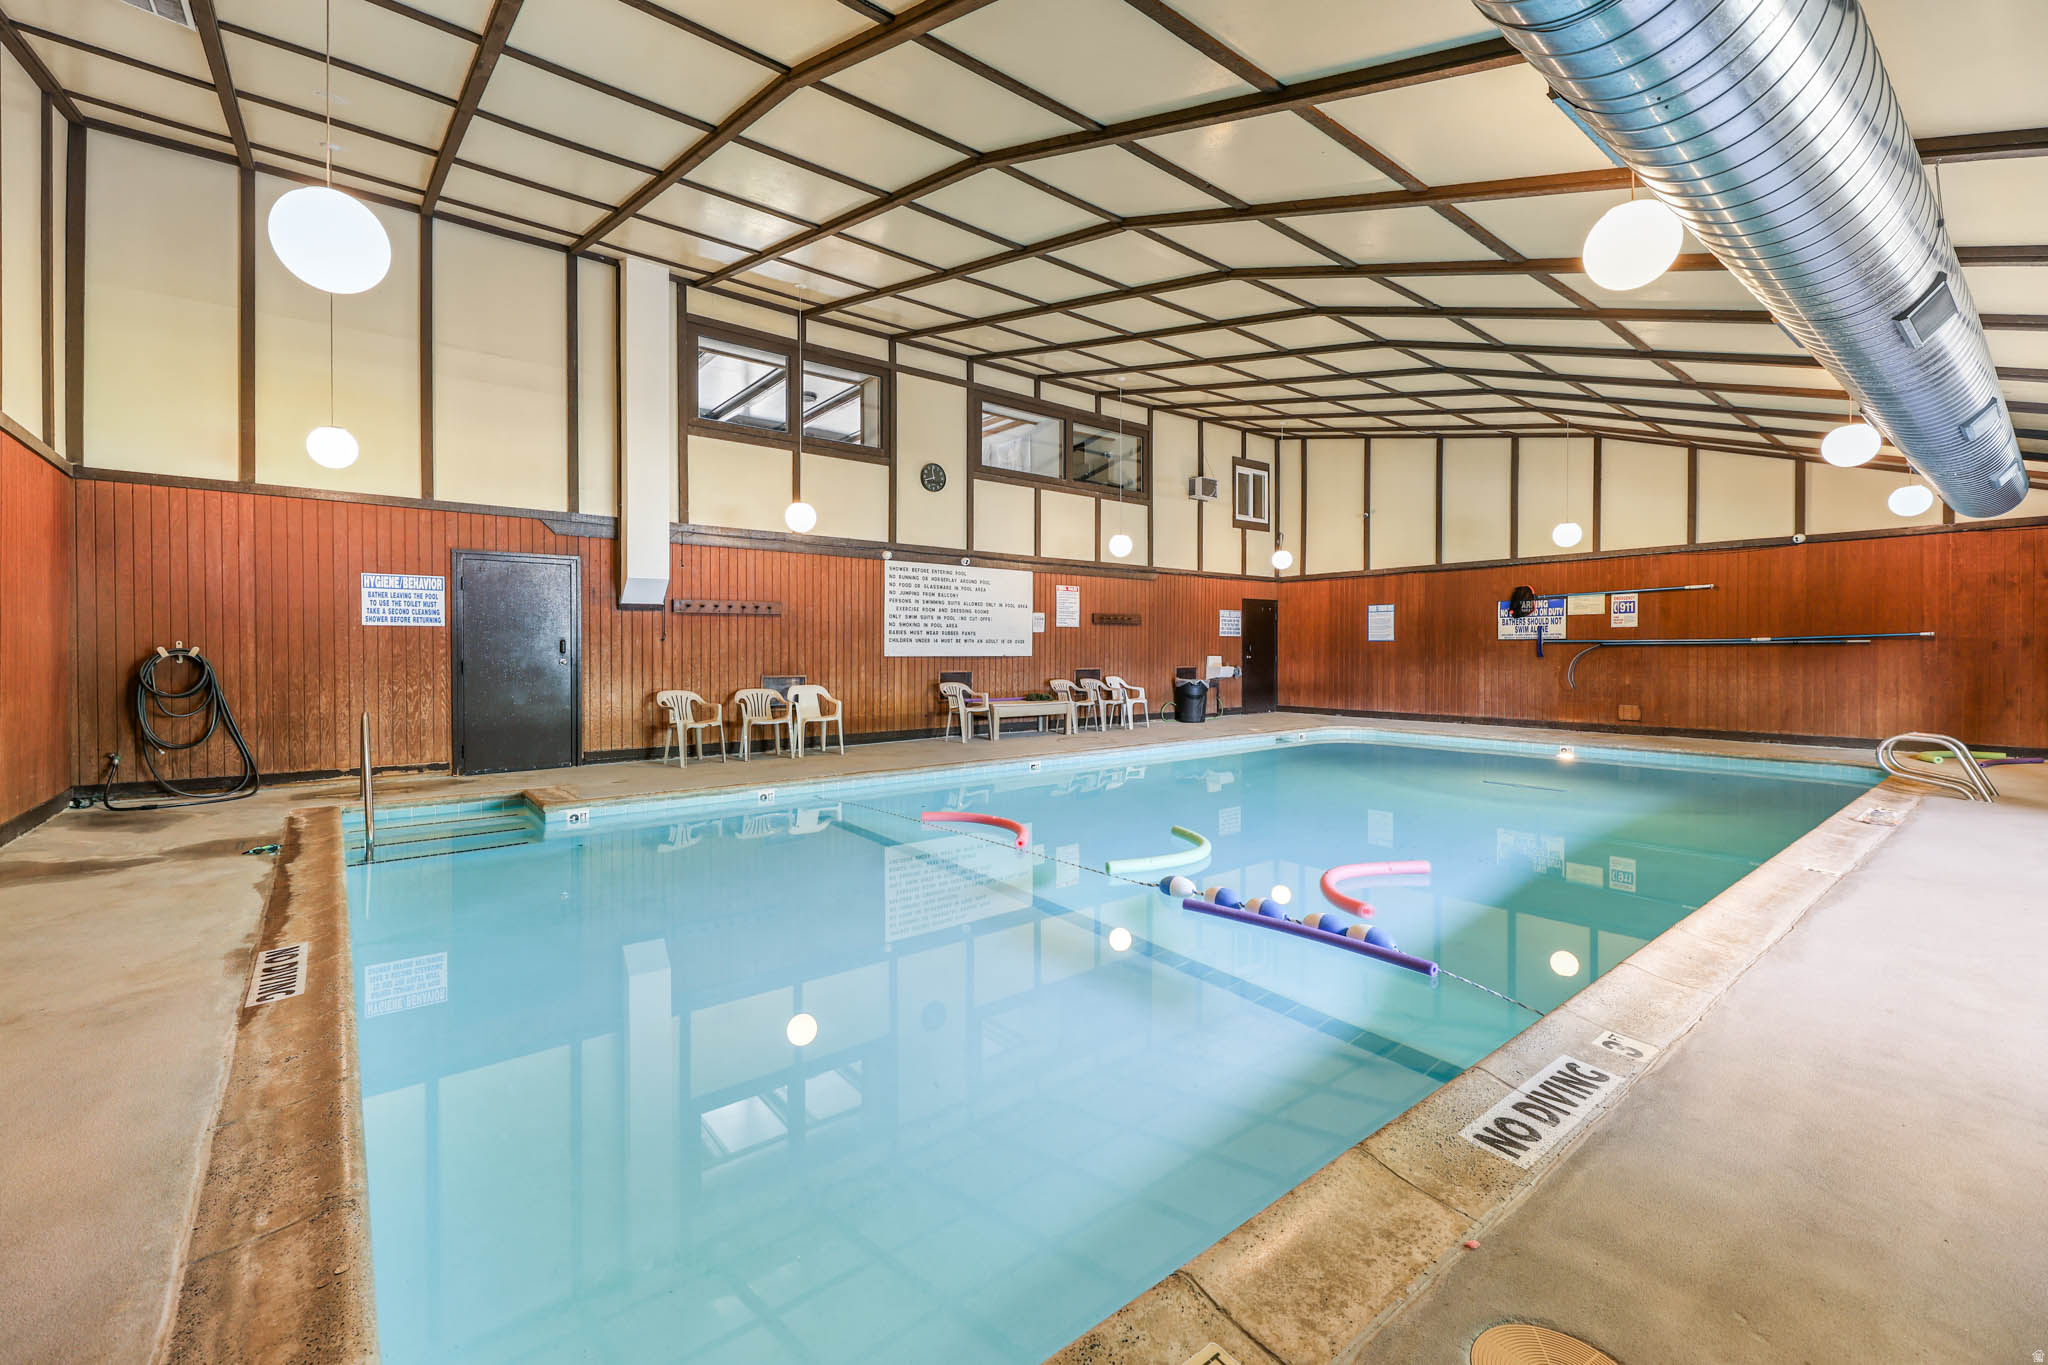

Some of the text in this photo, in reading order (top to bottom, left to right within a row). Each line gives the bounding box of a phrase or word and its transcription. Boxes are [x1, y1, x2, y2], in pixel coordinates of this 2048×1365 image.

[363, 575, 443, 590] HYGIENE/BEHAVIOR
[1518, 600, 1549, 608] ARNING
[1619, 602, 1634, 612] 911
[1501, 609, 1508, 617] NO
[365, 615, 388, 623] SHOWER
[1501, 617, 1562, 626] BATHERS SHOULD NOT
[1530, 625, 1549, 633] ALNE
[256, 945, 300, 1002] NO DIVING
[1473, 1062, 1610, 1160] NO DIVING
